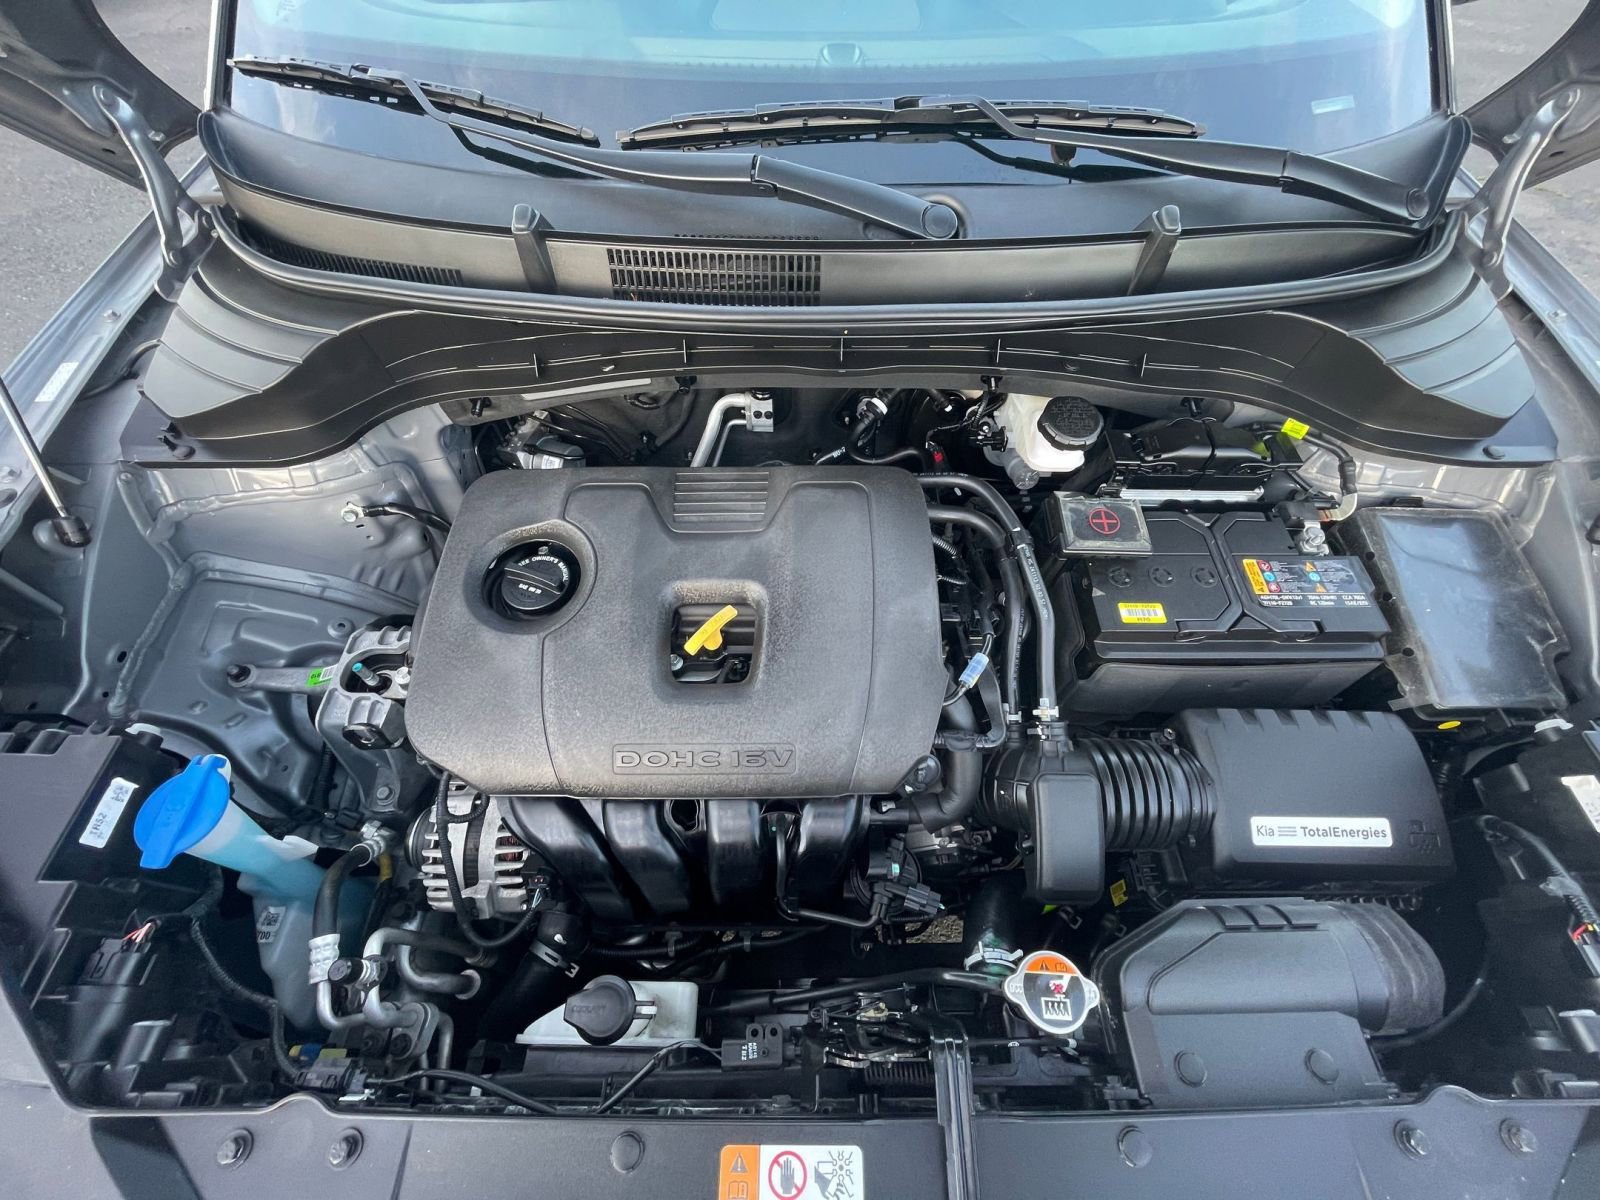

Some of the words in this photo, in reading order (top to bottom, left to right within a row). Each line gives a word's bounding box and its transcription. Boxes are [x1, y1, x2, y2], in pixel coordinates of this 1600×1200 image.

[615, 750, 721, 768] DOHC
[1256, 825, 1275, 838] Kia
[1300, 826, 1387, 840] TotalEnergies
